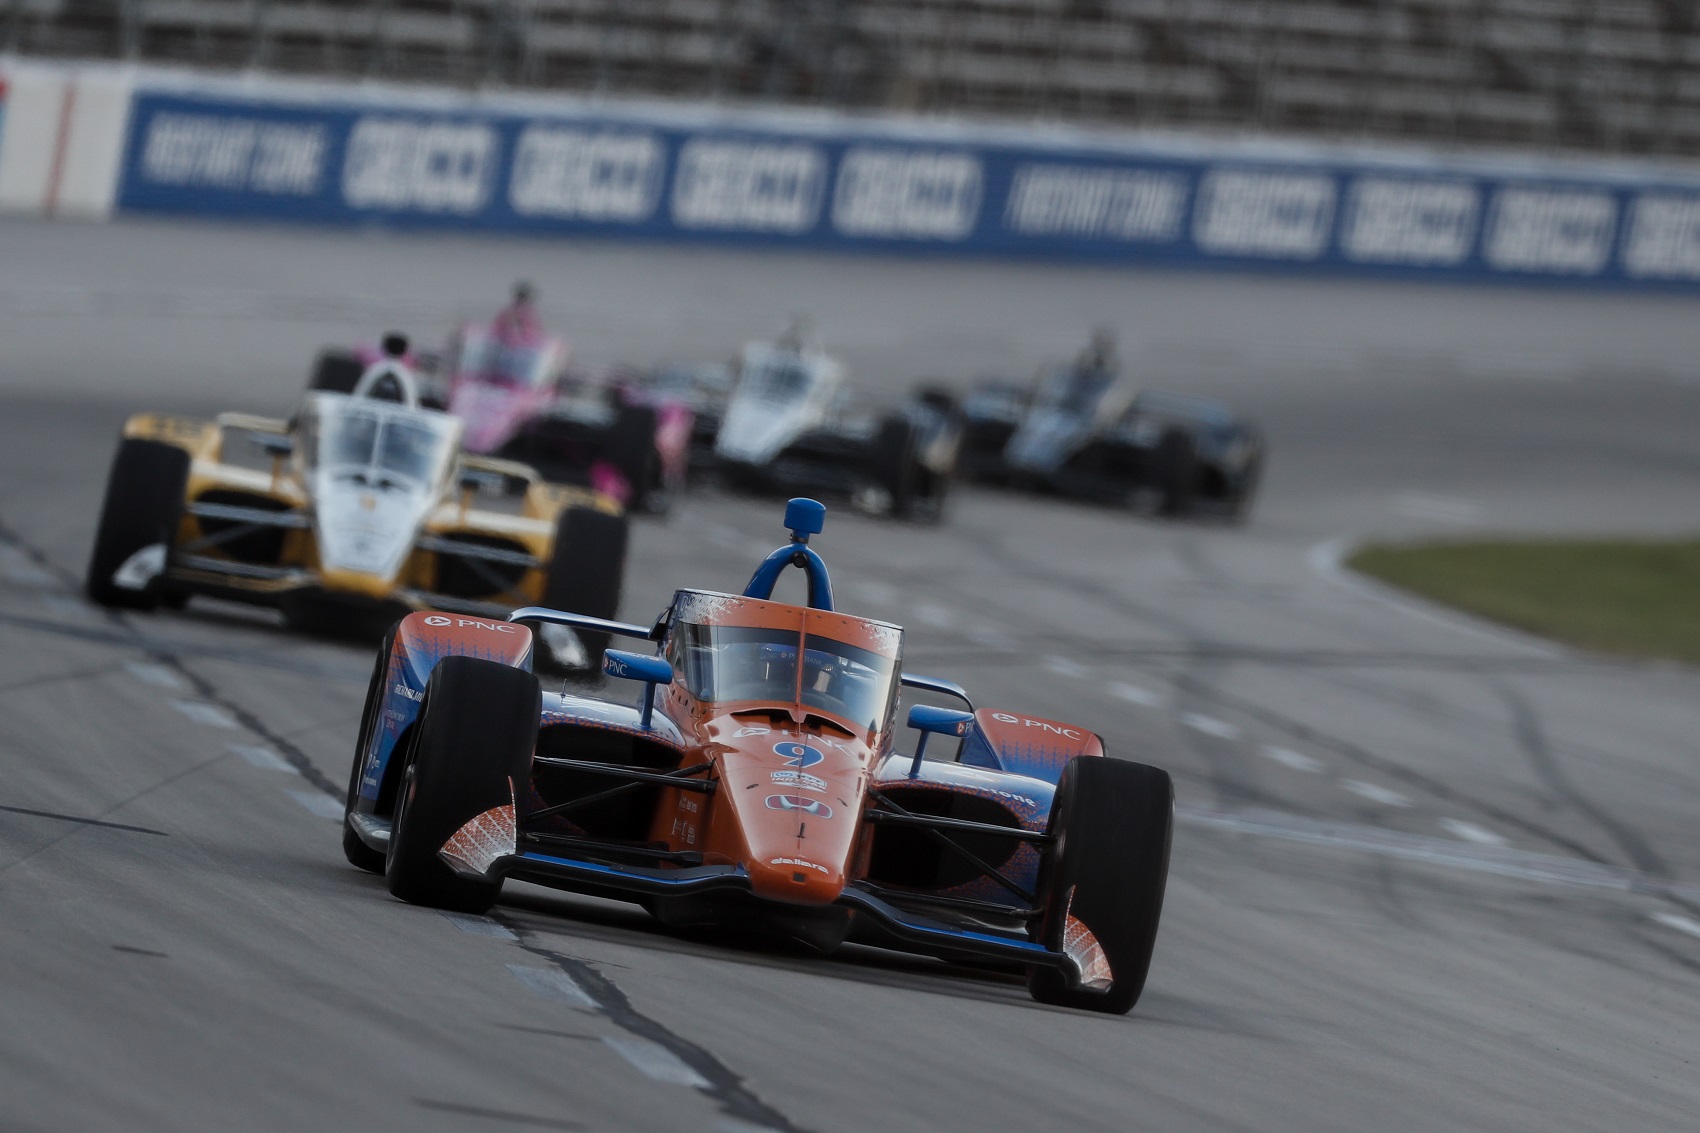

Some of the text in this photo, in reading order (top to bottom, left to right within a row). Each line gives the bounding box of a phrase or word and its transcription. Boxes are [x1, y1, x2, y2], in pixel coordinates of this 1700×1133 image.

[456, 618, 516, 634] PNC
[608, 659, 628, 676] PNC
[1023, 718, 1081, 741] PNC
[772, 740, 825, 769] 9
[770, 857, 829, 875] dallara
